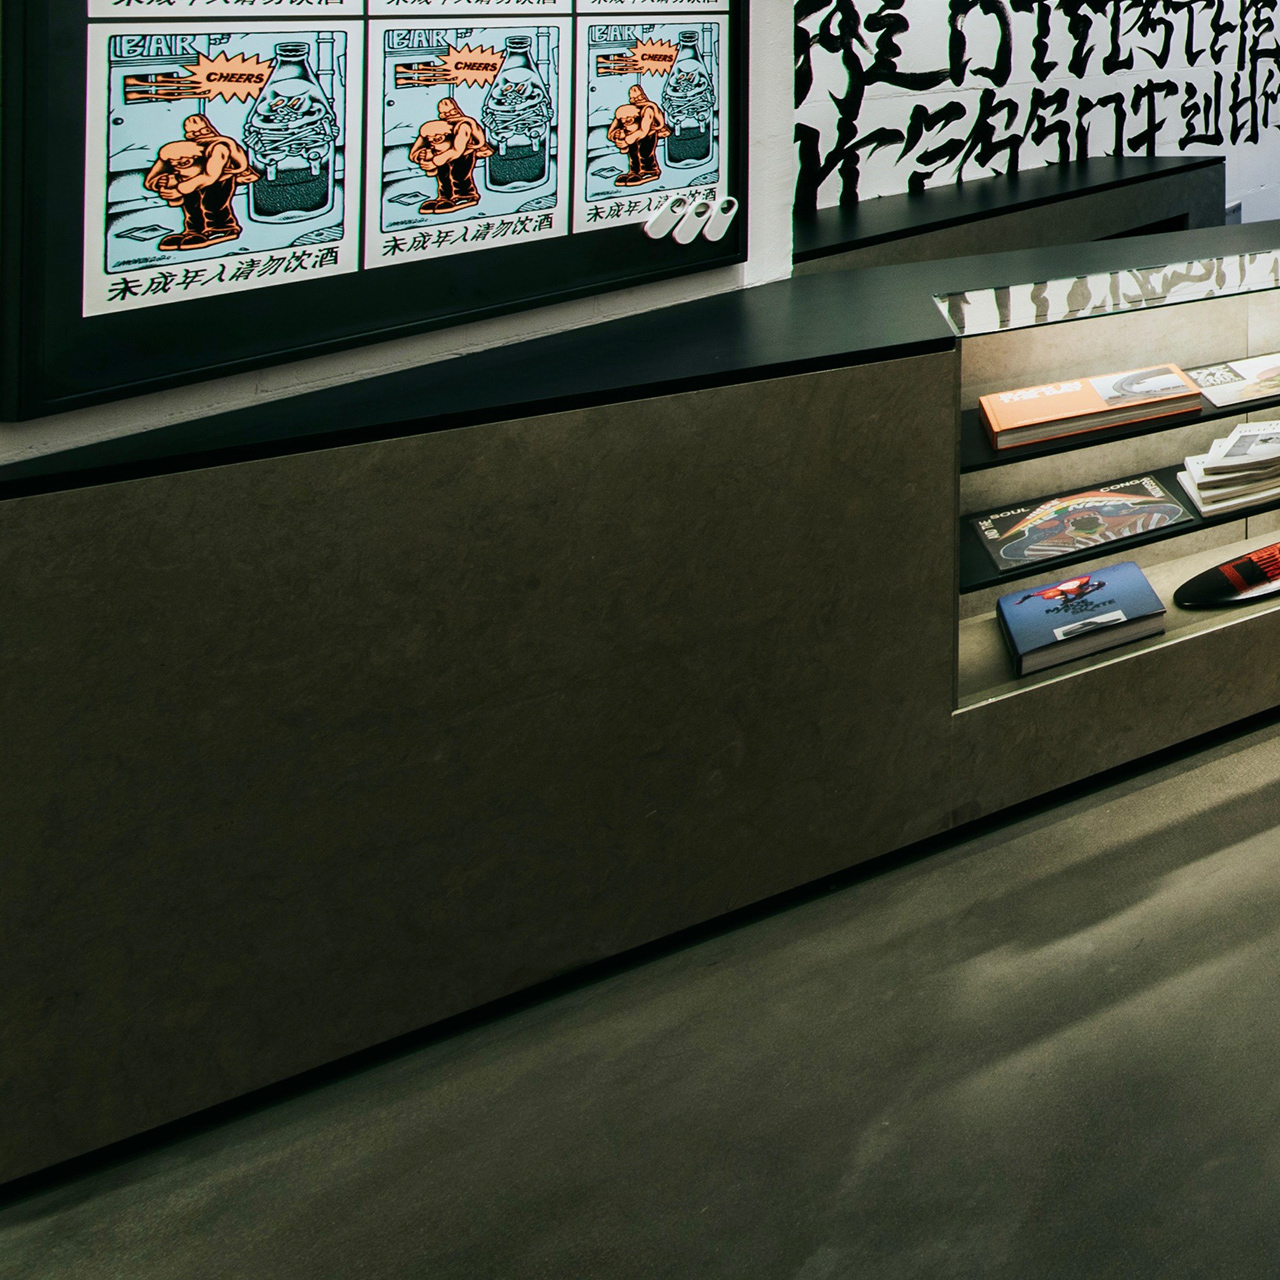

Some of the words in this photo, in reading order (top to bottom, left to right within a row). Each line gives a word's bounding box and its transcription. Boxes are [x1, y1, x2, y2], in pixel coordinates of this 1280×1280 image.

[394, 28, 448, 49] BAR
[593, 24, 637, 41] BAR
[121, 34, 198, 58] BAR
[640, 52, 674, 63] CHEERS
[454, 59, 498, 73] CHEERS
[206, 71, 265, 85] CHEERS
[990, 507, 1030, 520] SOUL
